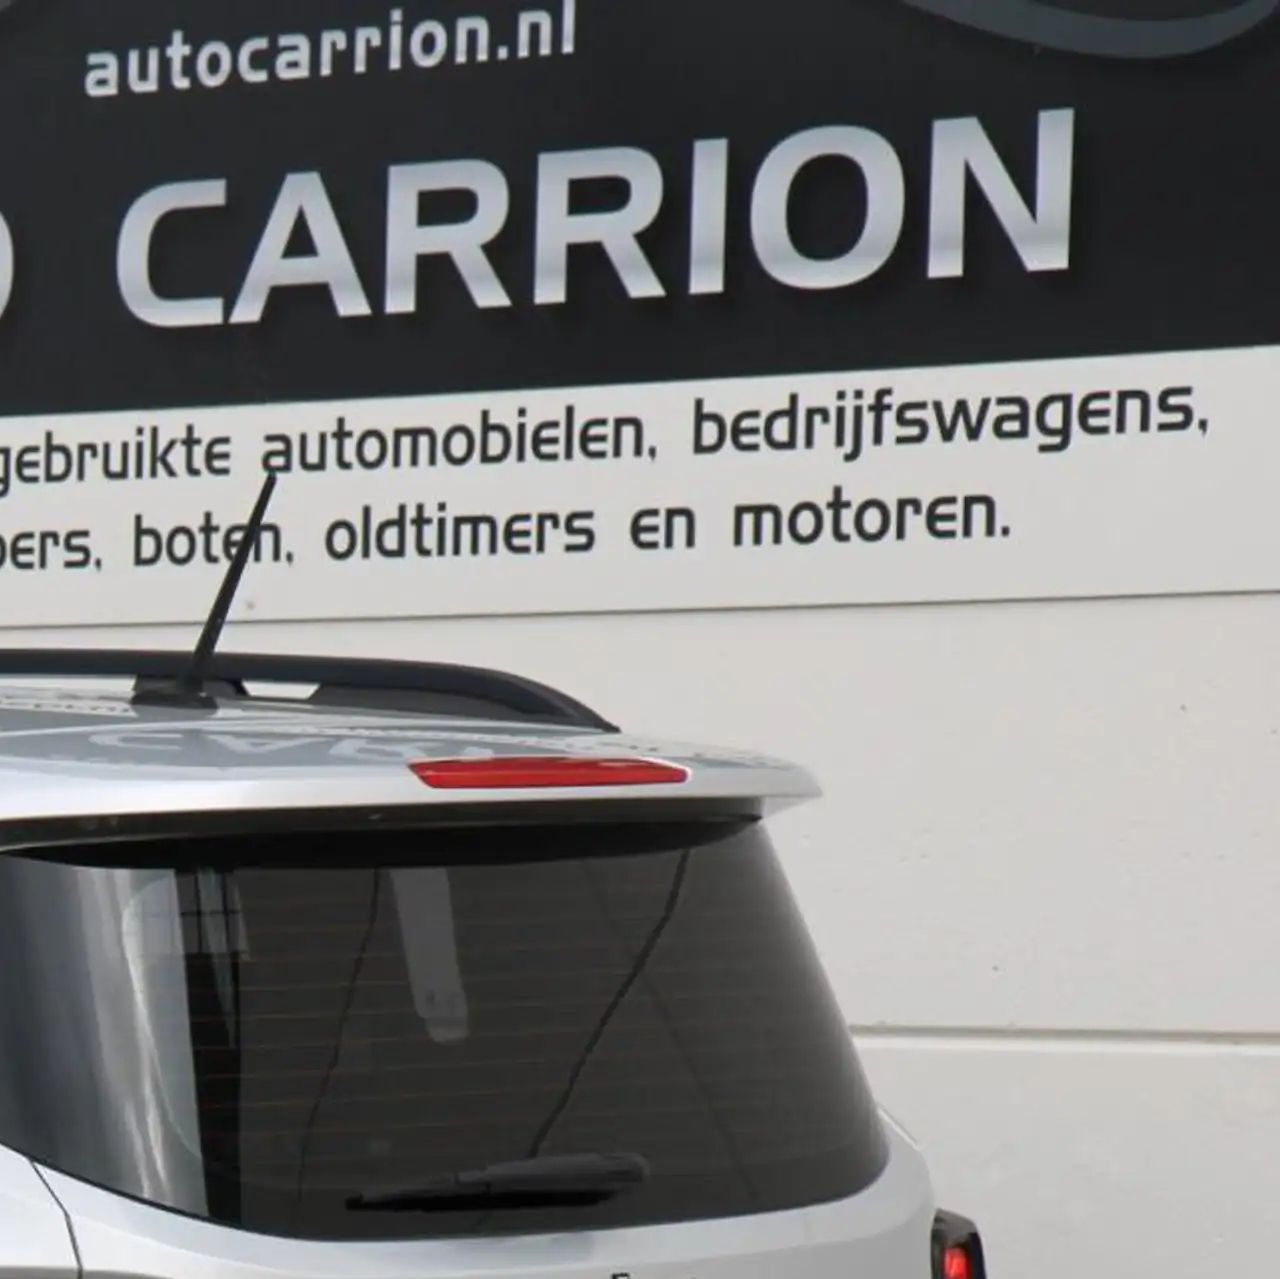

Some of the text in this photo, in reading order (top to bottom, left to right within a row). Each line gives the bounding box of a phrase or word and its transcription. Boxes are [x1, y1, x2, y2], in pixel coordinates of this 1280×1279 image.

[85, 0, 575, 97] autocarrion.nl
[116, 108, 1075, 328] CARRION
[262, 404, 657, 472] automobielen,
[693, 386, 1208, 463] bedrijfswagens,
[133, 511, 294, 567] boten,
[325, 501, 596, 561] oldtimers
[630, 507, 696, 550] en
[733, 485, 1010, 547] motoren.
